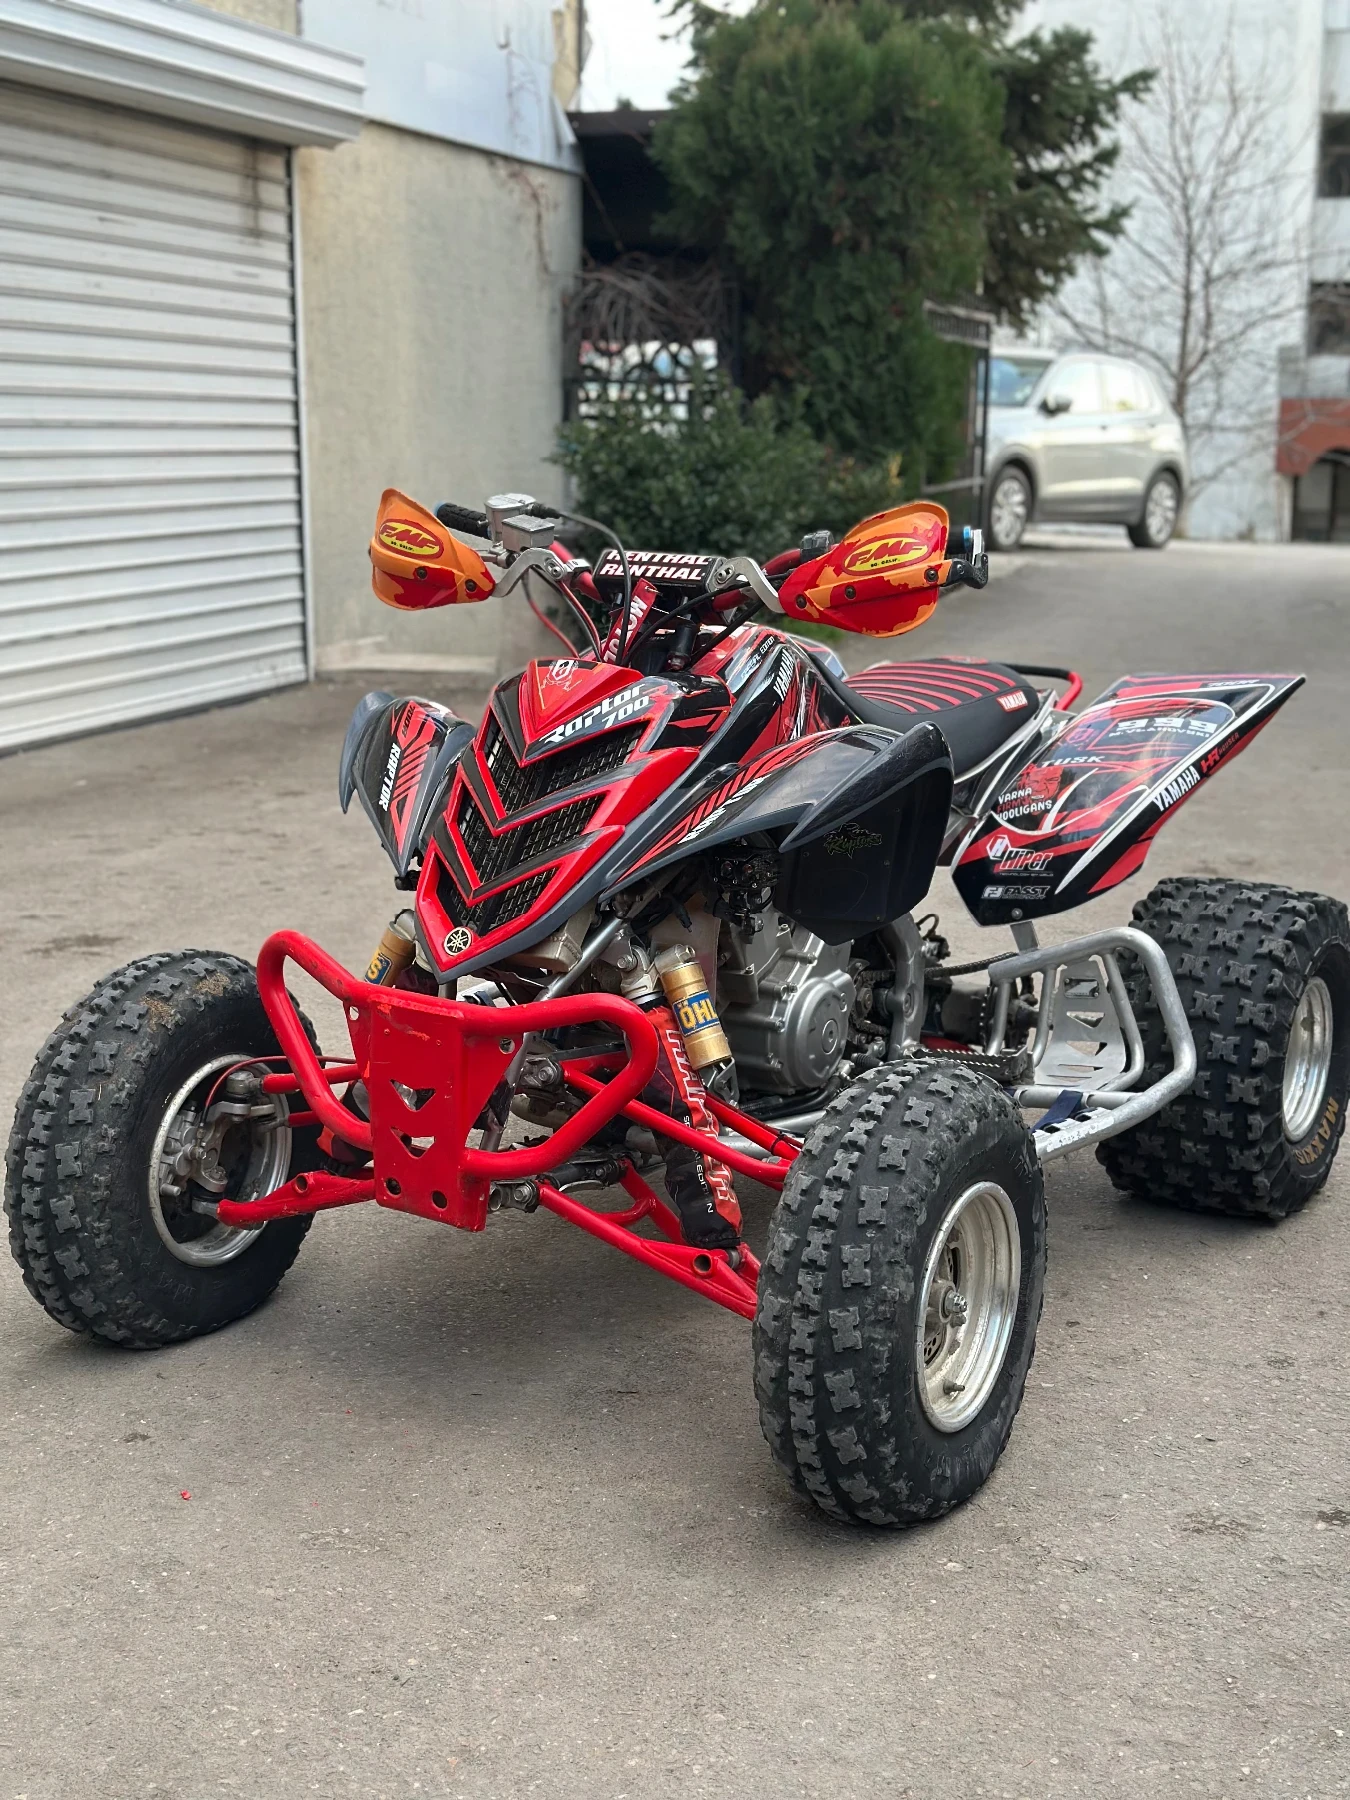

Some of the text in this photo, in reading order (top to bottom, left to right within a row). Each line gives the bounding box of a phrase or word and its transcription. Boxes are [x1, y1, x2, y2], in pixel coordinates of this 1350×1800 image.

[381, 524, 441, 549] FMF
[847, 540, 927, 568] FMF
[599, 563, 702, 581] RENTHAL
[773, 648, 796, 702] YAMAHA
[602, 695, 650, 730] 700
[1116, 717, 1218, 734] 999
[1042, 755, 1105, 768] TUSK
[378, 742, 401, 812] RAPTOR
[1152, 765, 1201, 812] YAMAHA
[998, 787, 1033, 805] VARNA
[1294, 1096, 1339, 1165] MAXXIS
